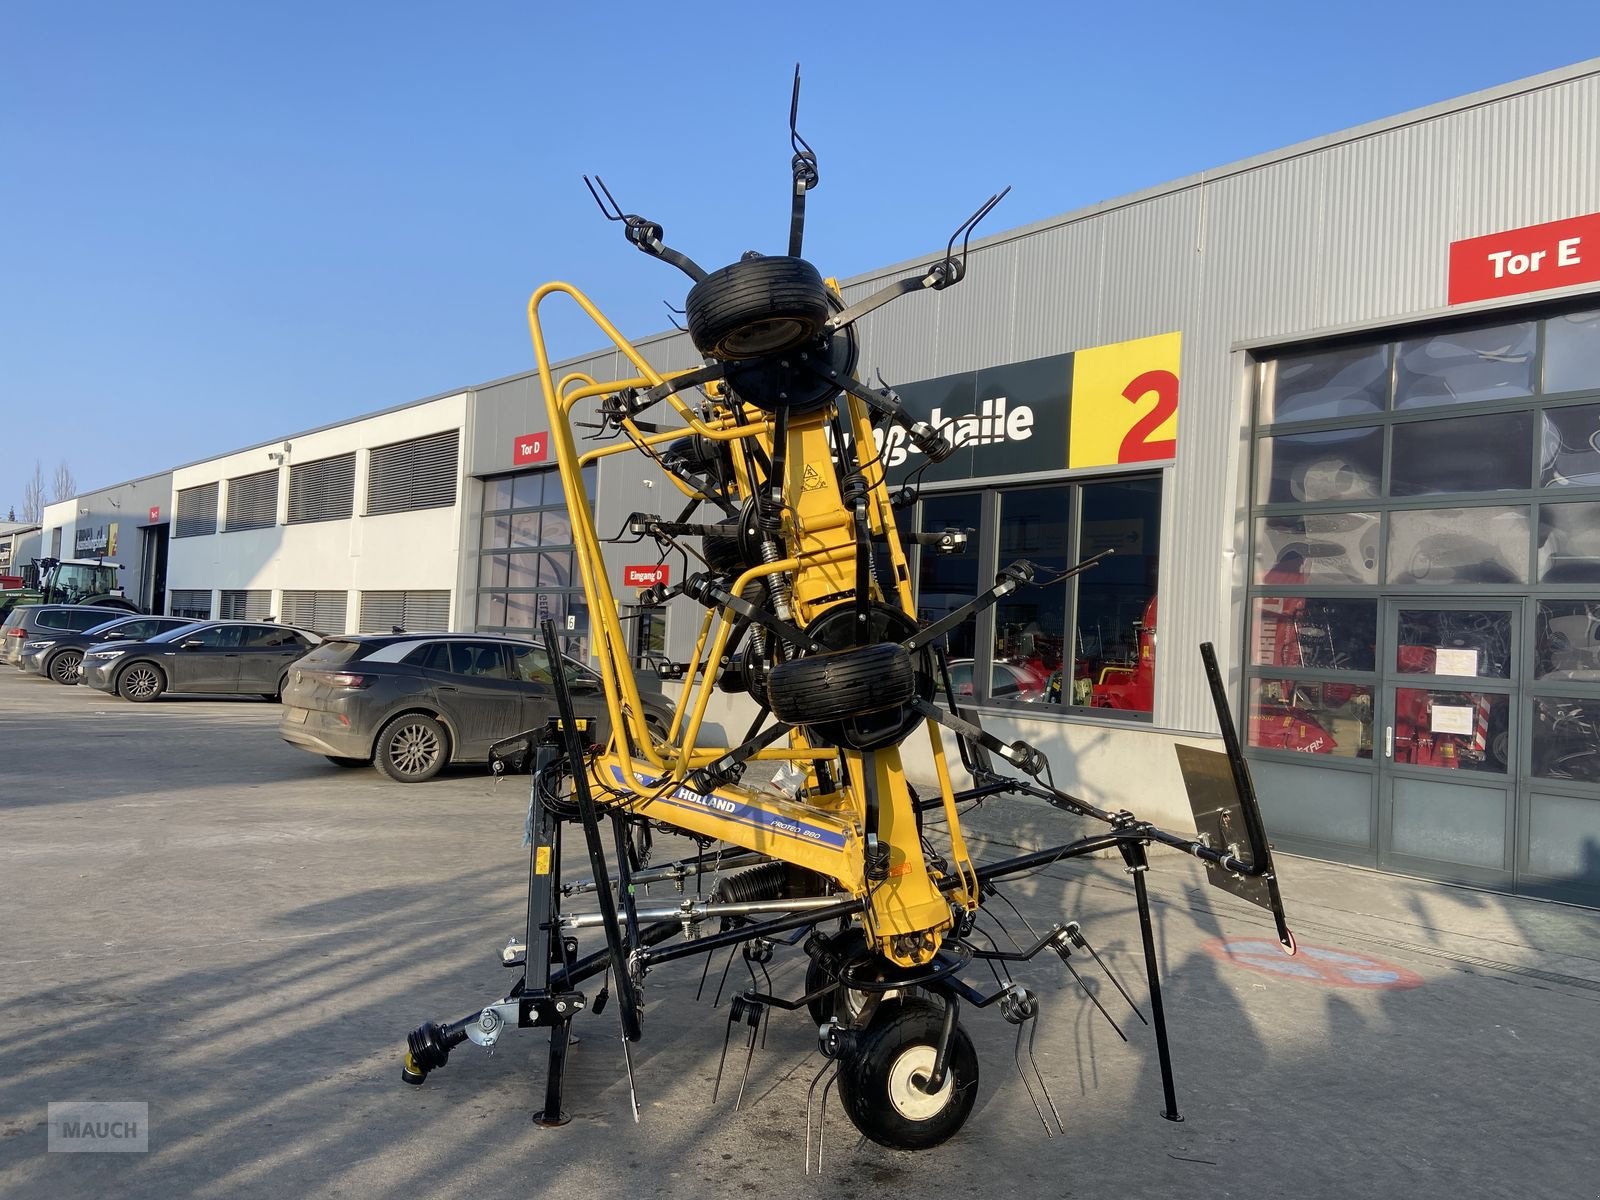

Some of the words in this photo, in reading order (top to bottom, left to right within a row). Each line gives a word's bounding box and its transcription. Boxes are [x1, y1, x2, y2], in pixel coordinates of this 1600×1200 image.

[1487, 249, 1547, 279] Tor
[1557, 237, 1581, 267] E
[1117, 369, 1179, 464] 2
[520, 443, 533, 456] Tor
[533, 441, 540, 454] D
[630, 570, 656, 582] Eingang
[656, 570, 662, 580] D
[568, 617, 574, 628] 6
[679, 787, 736, 813] HOLLAND
[803, 829, 821, 840] 880
